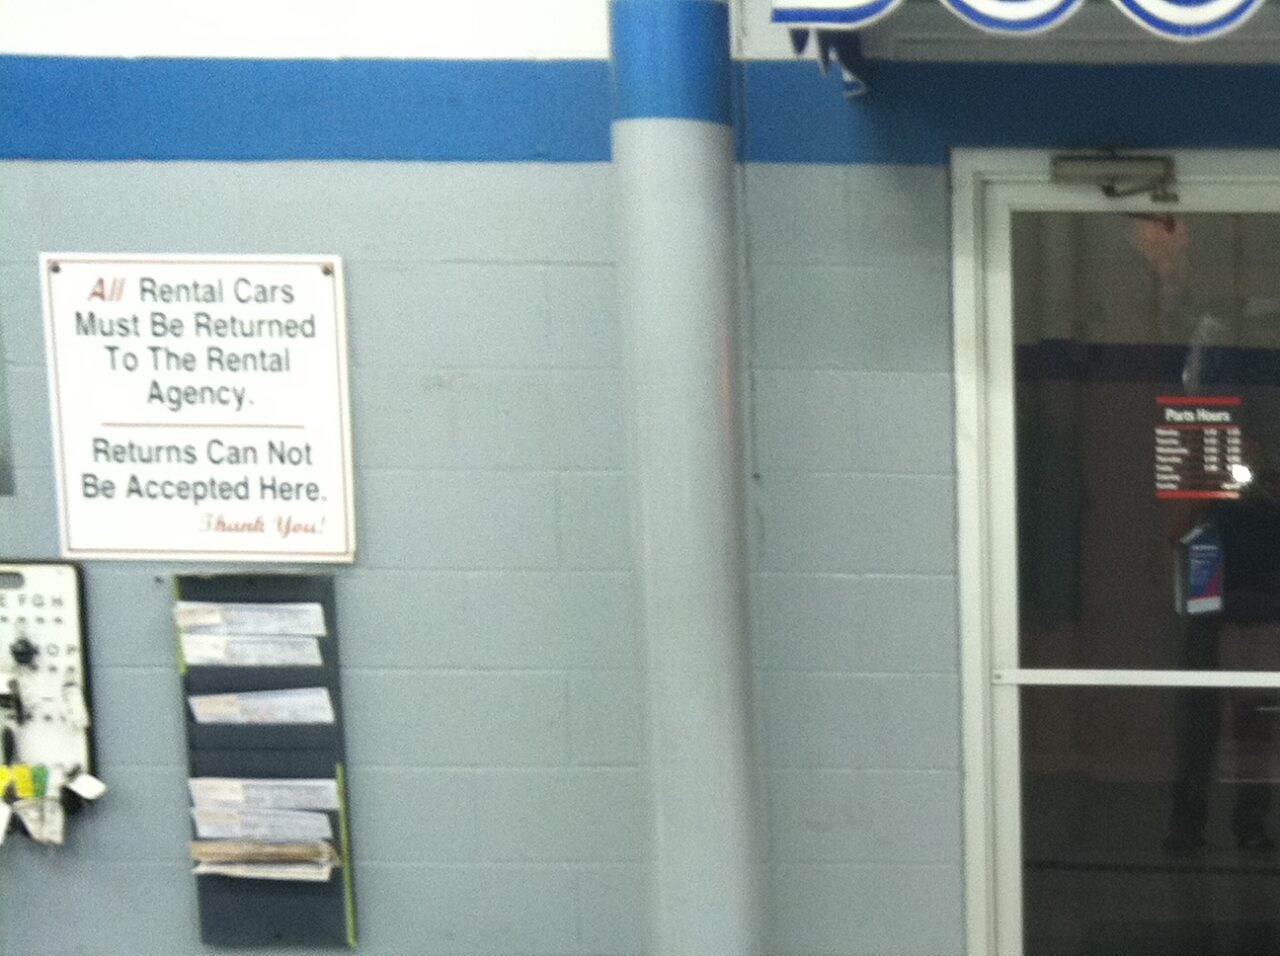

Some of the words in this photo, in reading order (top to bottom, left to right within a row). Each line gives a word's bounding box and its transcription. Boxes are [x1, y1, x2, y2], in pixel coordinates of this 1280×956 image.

[88, 277, 126, 302] All
[139, 277, 224, 303] Rental
[233, 277, 295, 304] Cars
[75, 311, 140, 337] Must
[150, 312, 184, 337] Be
[194, 312, 316, 338] Returned
[104, 346, 139, 372] To
[147, 346, 197, 372] The
[206, 346, 291, 372] Rental
[147, 379, 254, 412] Agency.
[1165, 408, 1195, 422] Parts
[1197, 408, 1230, 422] Hours
[92, 438, 198, 465] Returns
[206, 438, 258, 465] Can
[267, 440, 313, 466] Not
[81, 473, 116, 498] Be
[126, 474, 250, 505] Accepted
[259, 475, 327, 502] Here.
[200, 513, 265, 534] Thank
